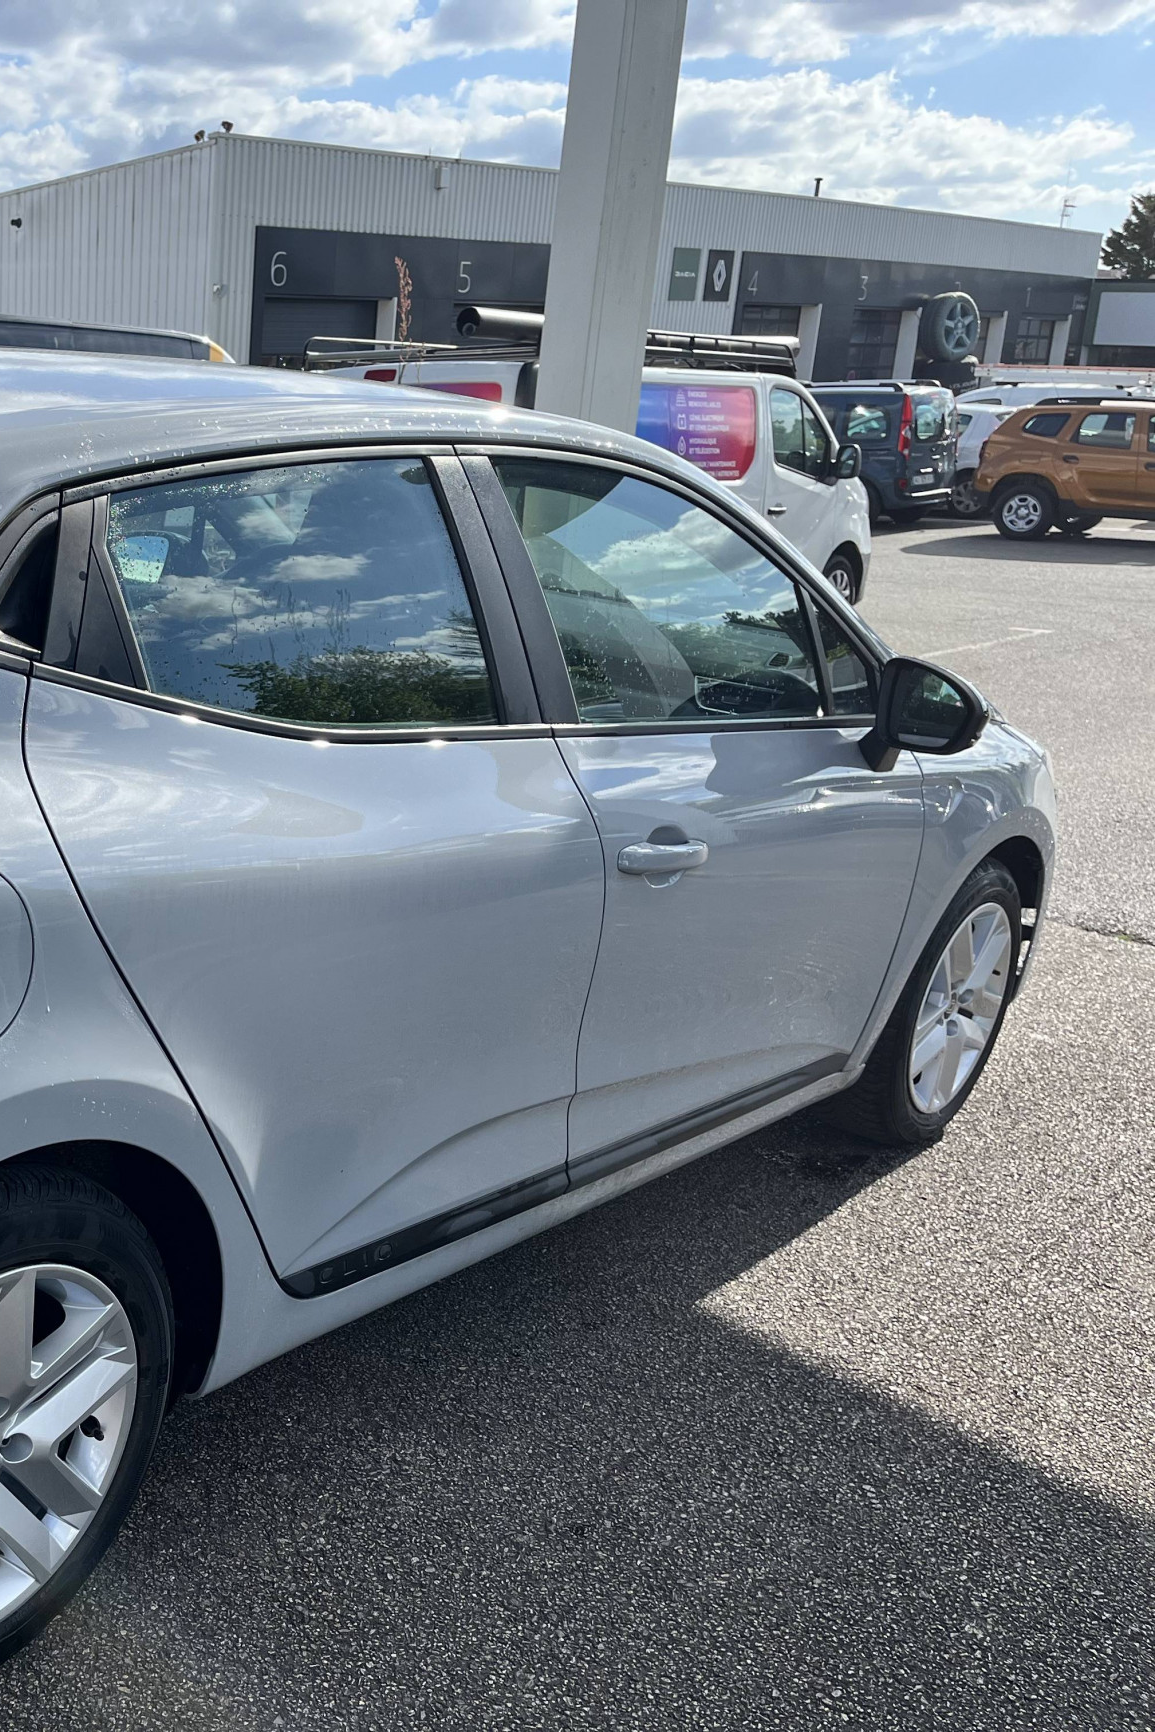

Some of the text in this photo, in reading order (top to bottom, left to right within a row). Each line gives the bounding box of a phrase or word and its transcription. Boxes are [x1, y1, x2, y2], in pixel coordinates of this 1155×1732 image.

[270, 251, 287, 287] 6
[457, 261, 472, 294] 5
[747, 270, 759, 297] 4
[857, 275, 869, 301] 3
[319, 1242, 393, 1284] CLIO
